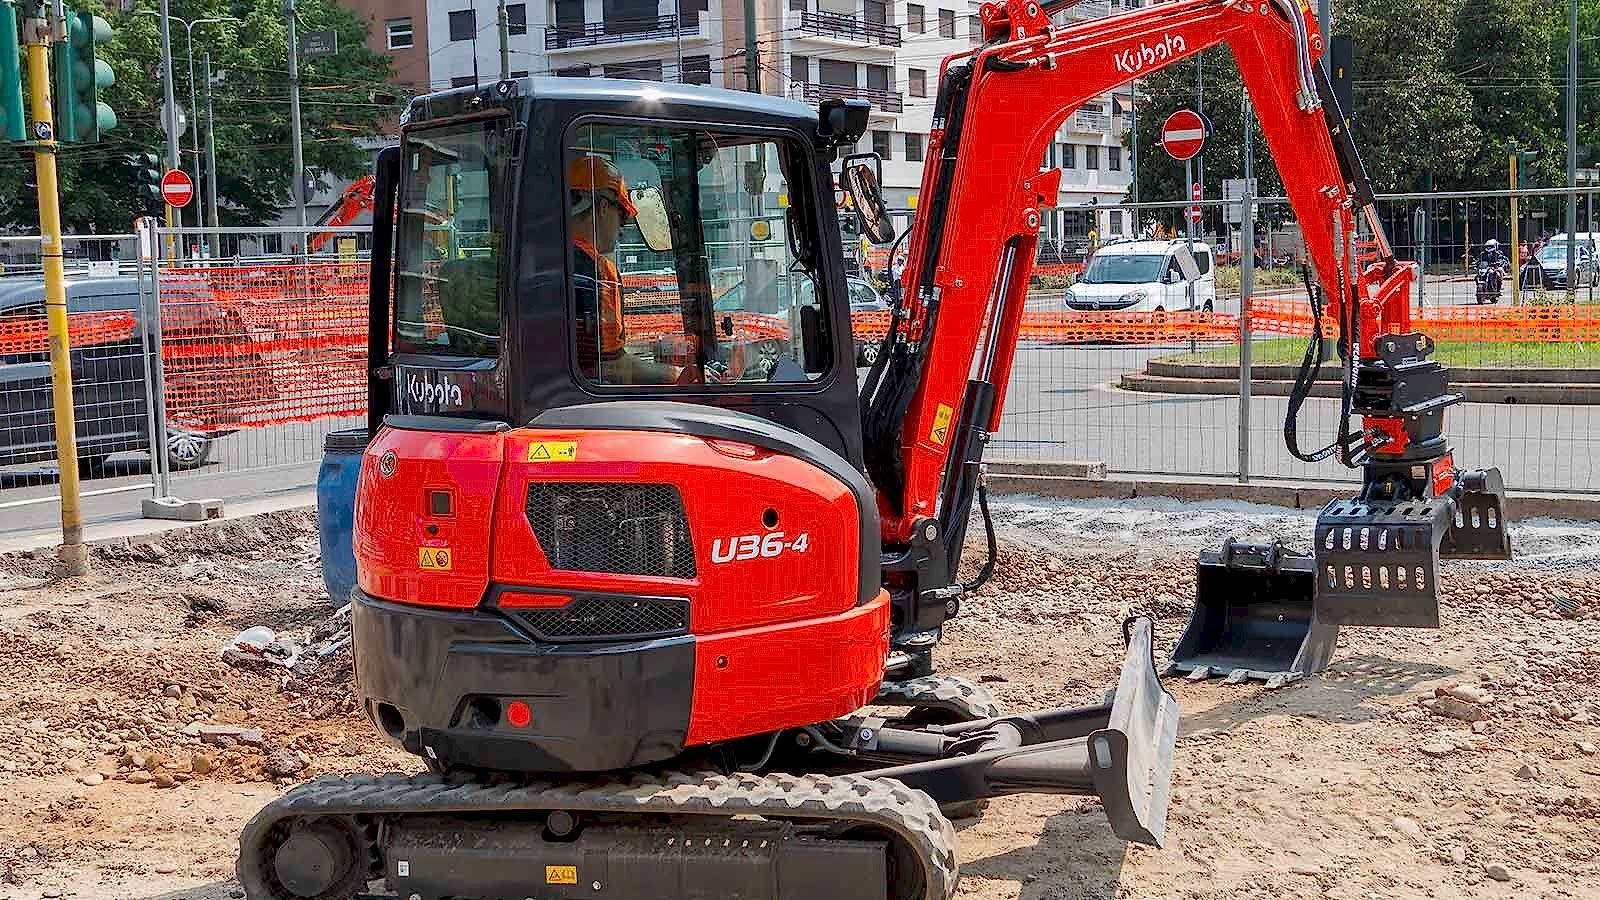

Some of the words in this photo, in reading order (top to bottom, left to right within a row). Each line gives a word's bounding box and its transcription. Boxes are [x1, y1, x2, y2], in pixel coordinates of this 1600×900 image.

[1113, 33, 1186, 73] Kubota
[406, 373, 463, 406] Kubota
[711, 531, 809, 564] U36-4
